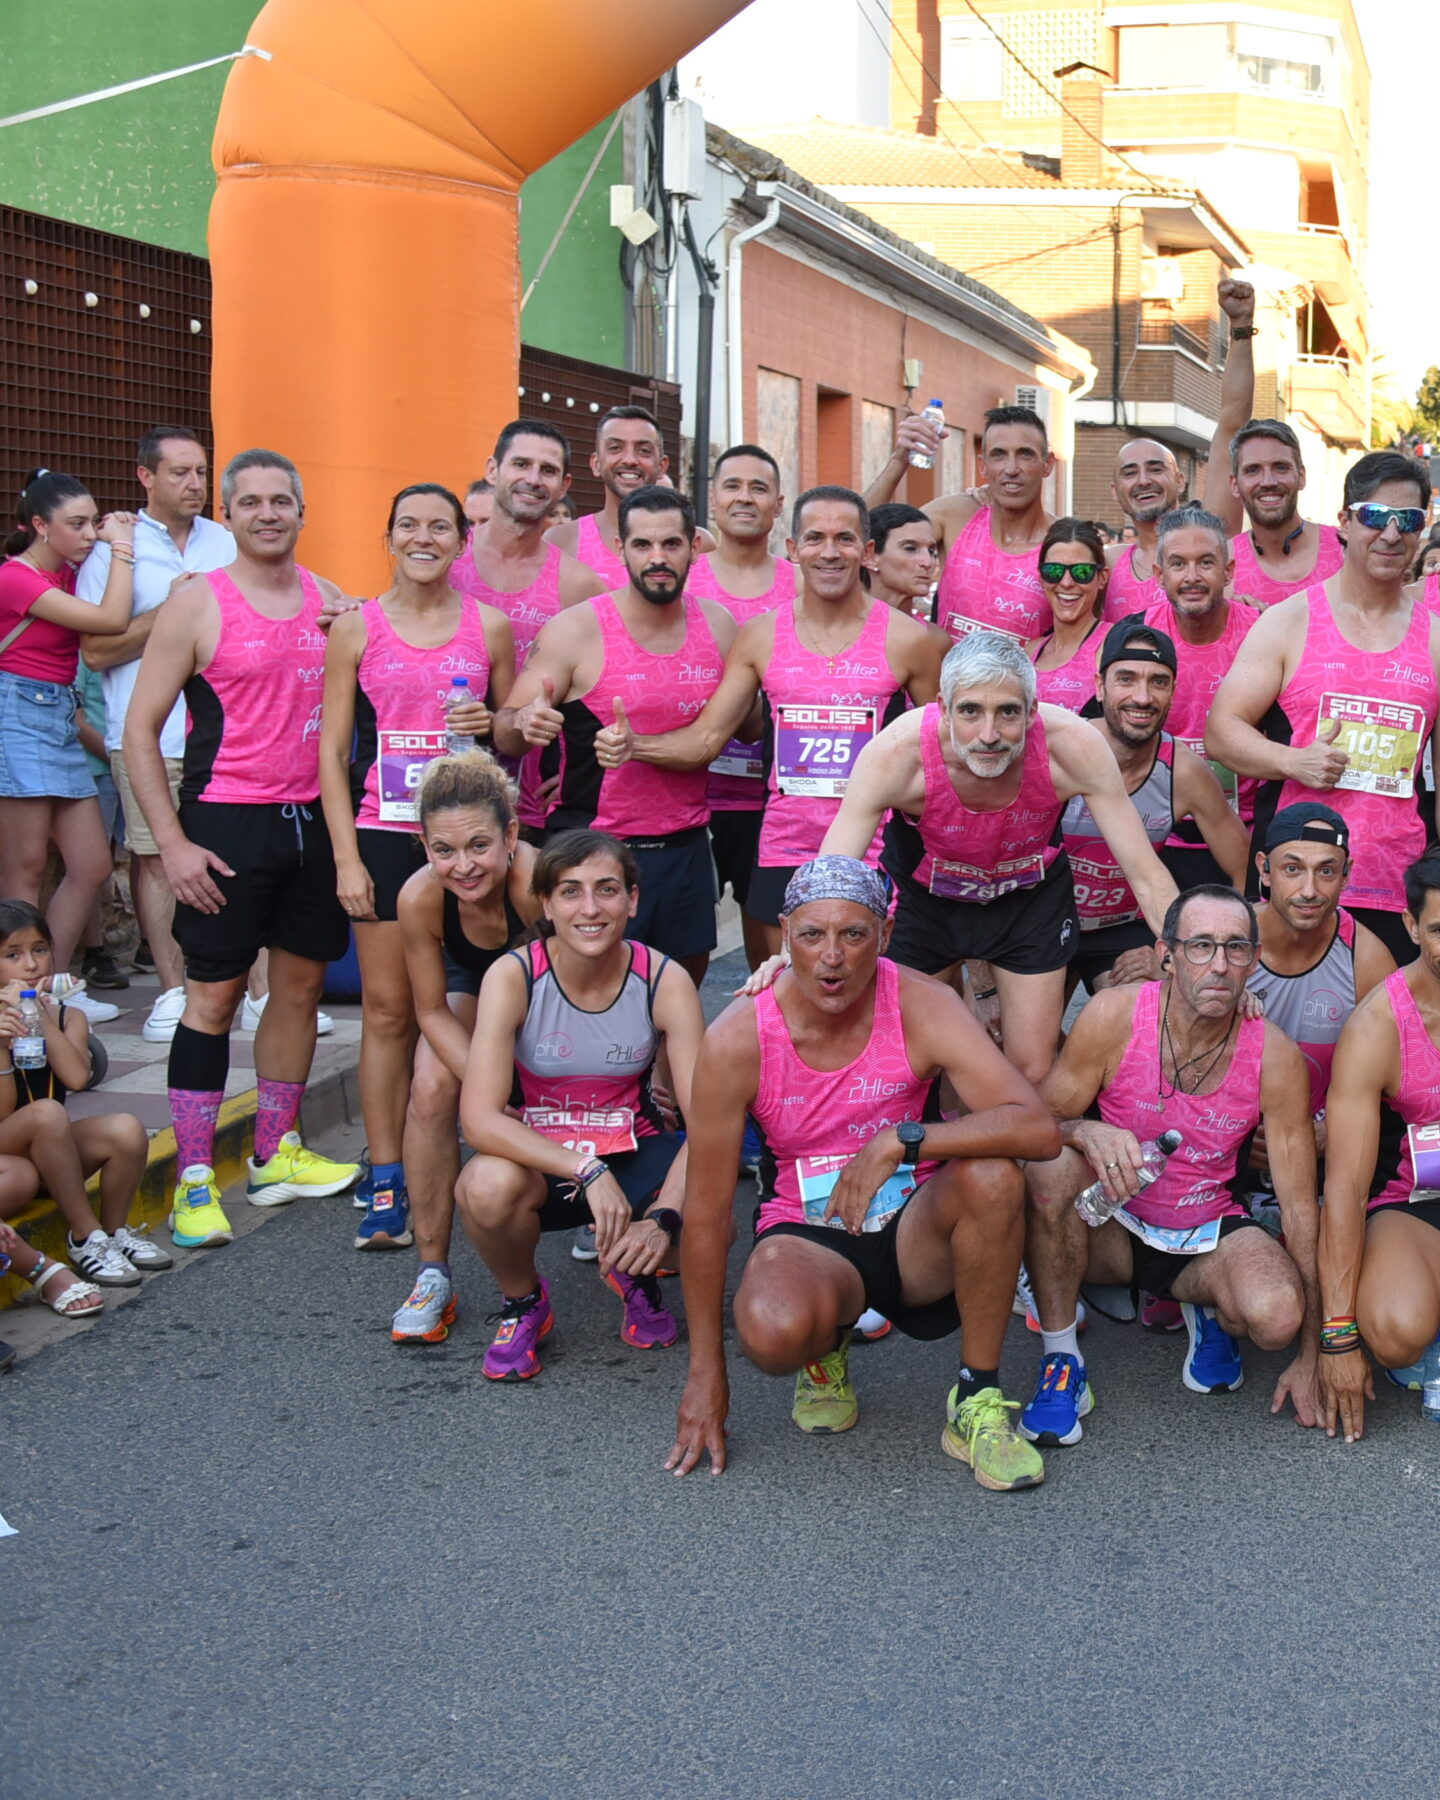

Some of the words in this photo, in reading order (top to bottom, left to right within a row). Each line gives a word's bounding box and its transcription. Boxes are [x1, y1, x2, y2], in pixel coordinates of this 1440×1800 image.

[297, 629, 328, 647] PHIG
[678, 663, 718, 681] PHIGP
[835, 660, 879, 676] PHIGP
[1383, 661, 1430, 685] PHIGP
[783, 709, 867, 725] SOLISS
[1330, 698, 1415, 726] SOLISS
[389, 735, 448, 750] SOLI
[799, 737, 852, 764] 725
[1347, 730, 1397, 759] 105
[942, 856, 1037, 880] SOLSS
[849, 1077, 907, 1098] PHIGP
[532, 1111, 624, 1128] SOLISS
[1196, 1108, 1247, 1130] PHIGP
